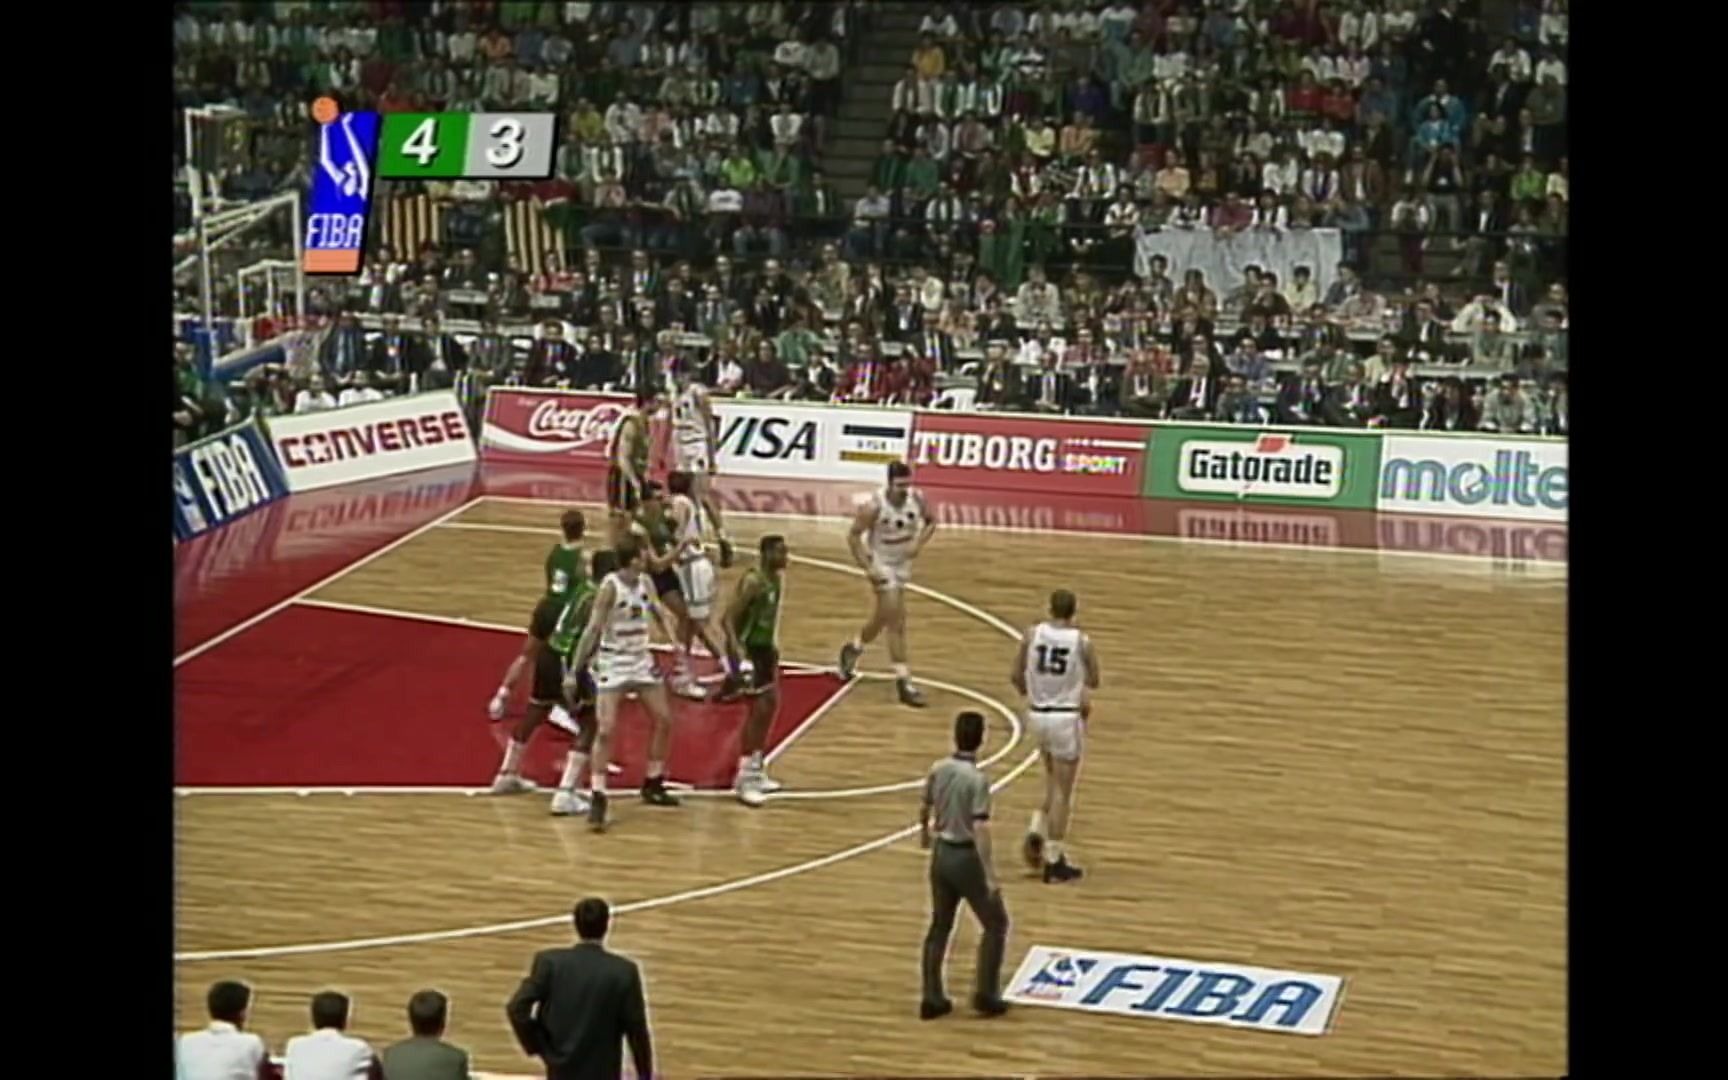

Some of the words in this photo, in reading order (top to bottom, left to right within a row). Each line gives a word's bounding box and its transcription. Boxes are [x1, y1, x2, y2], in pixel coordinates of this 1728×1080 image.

[278, 411, 466, 469] CONVERSE
[711, 415, 818, 460] VISA
[913, 431, 1057, 472] TUBORG
[191, 432, 271, 521] FIBA
[1063, 453, 1127, 475] SPORT
[1189, 448, 1333, 486] Gatorade
[1035, 644, 1071, 676] 15
[1080, 963, 1324, 1028] FIBA
